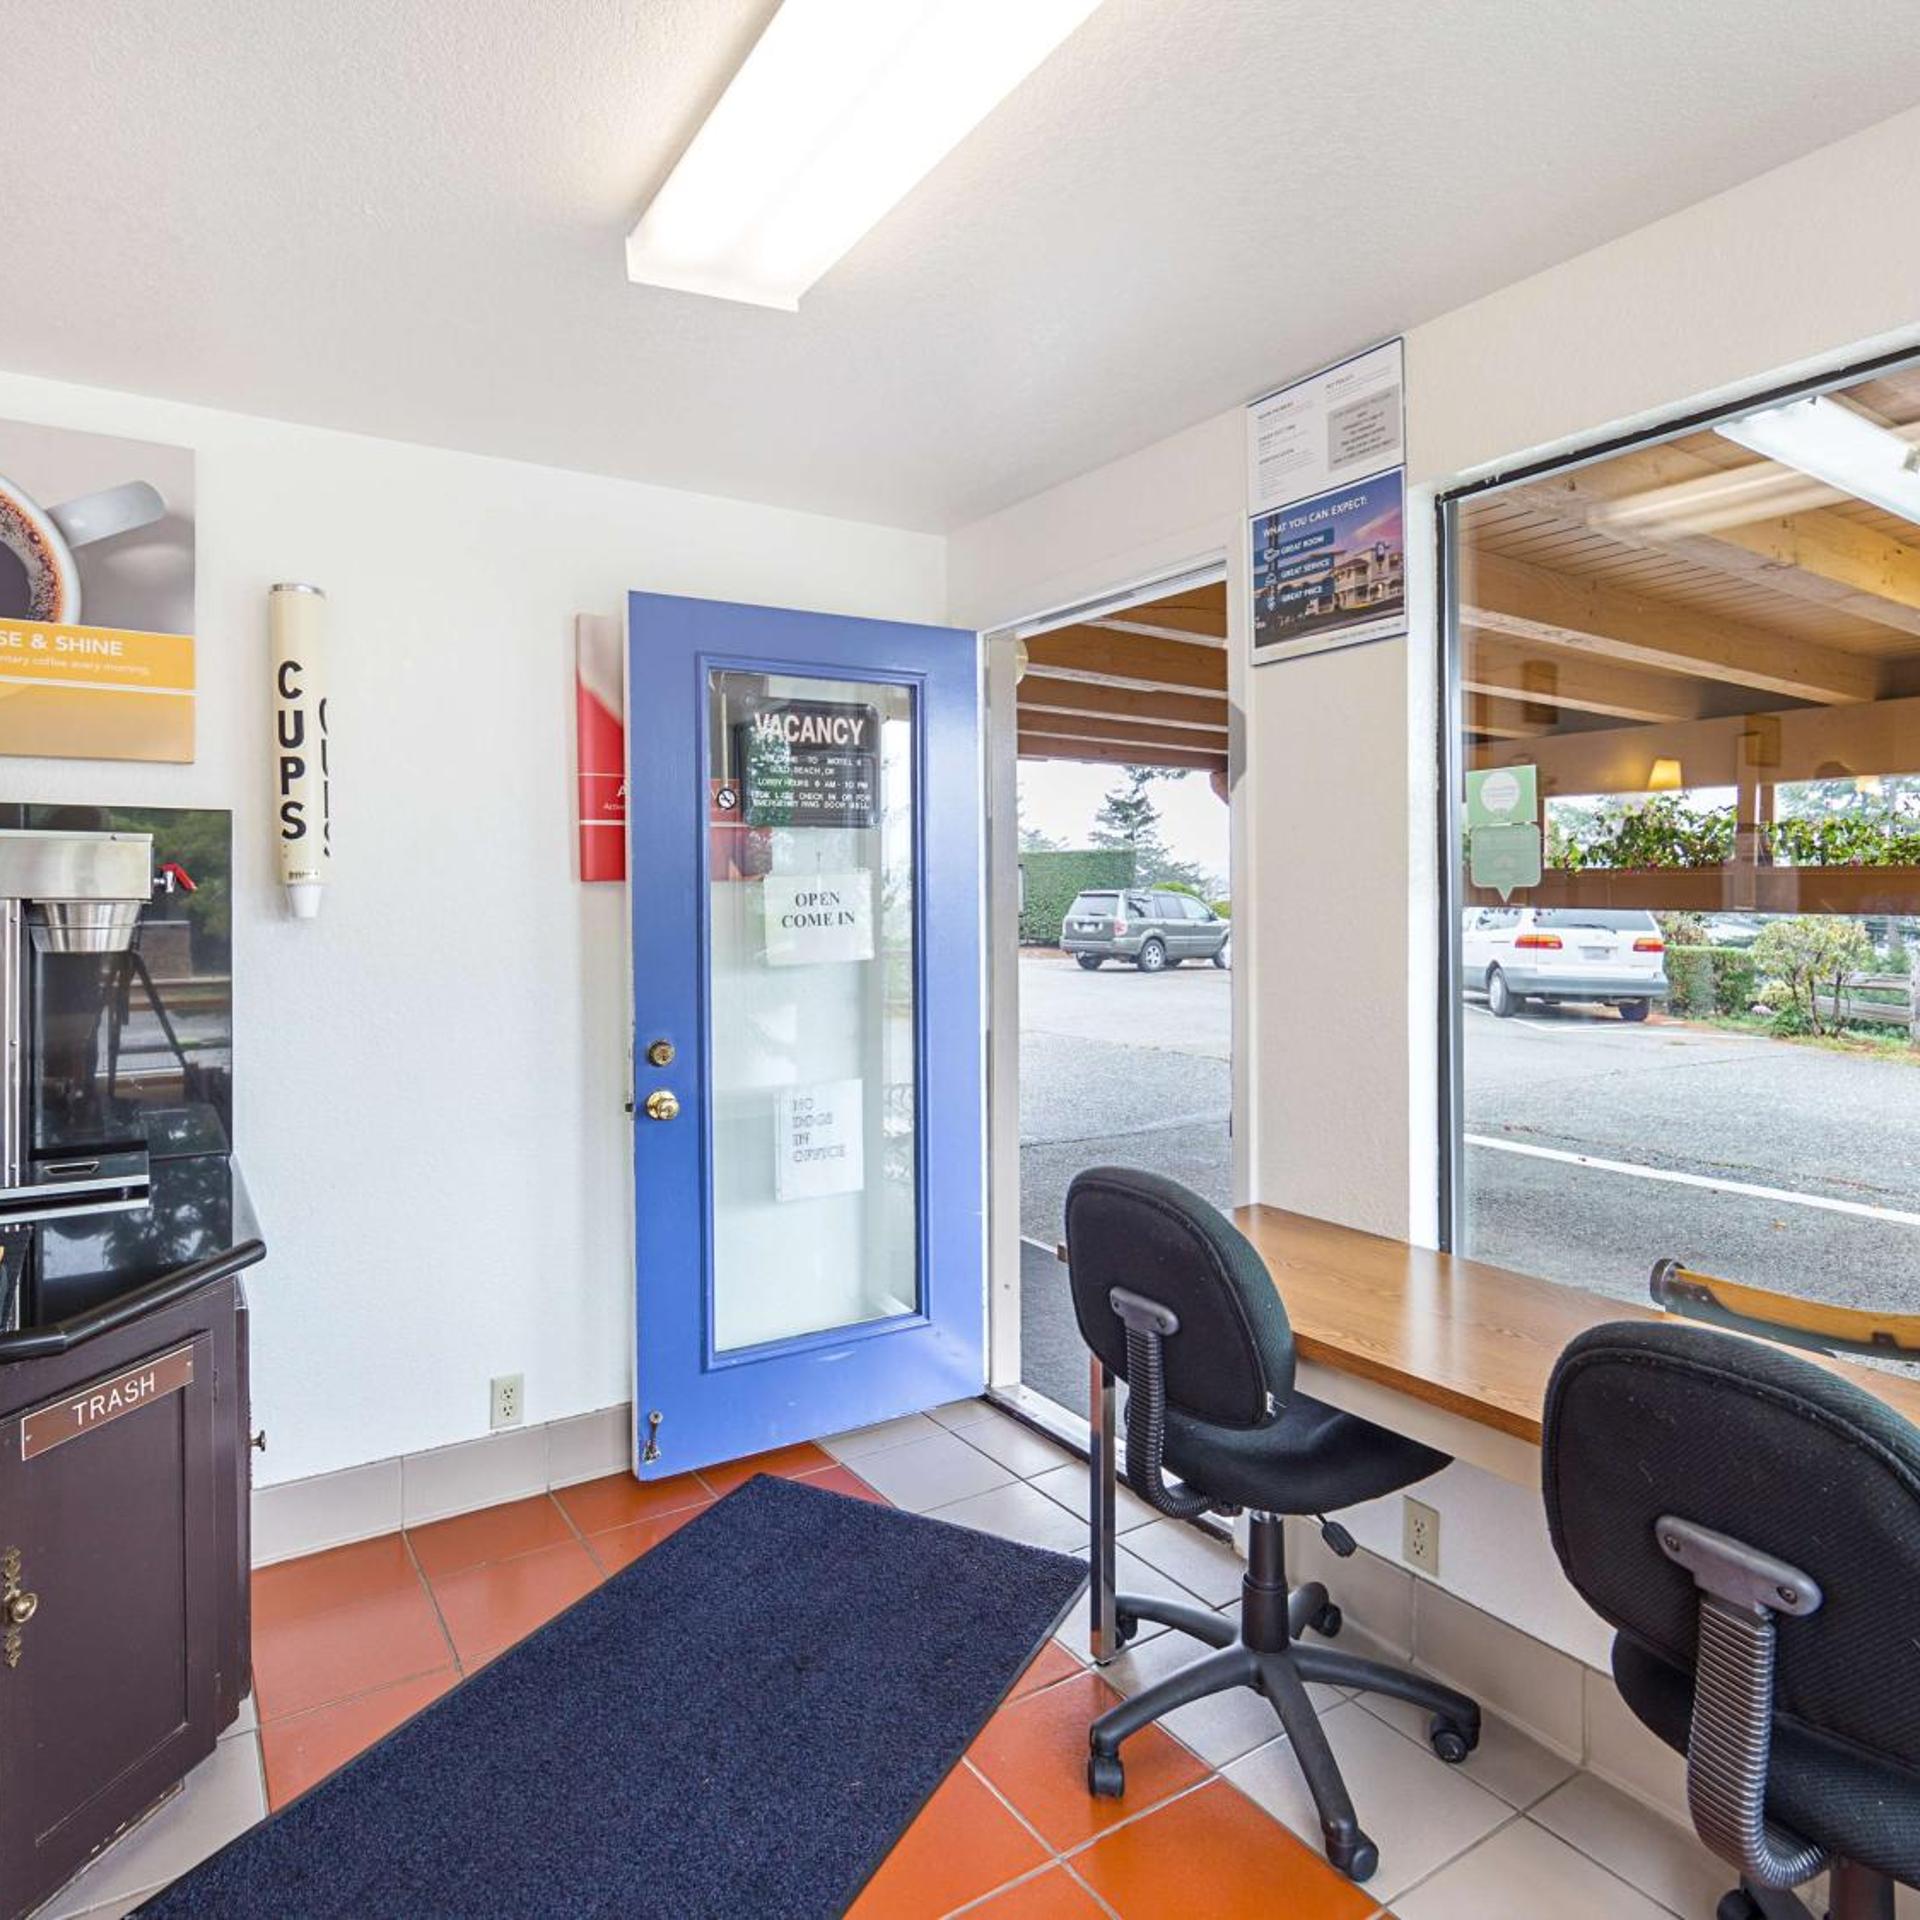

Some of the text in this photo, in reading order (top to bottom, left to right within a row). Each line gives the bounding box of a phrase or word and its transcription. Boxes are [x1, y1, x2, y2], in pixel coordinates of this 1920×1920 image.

[1263, 522, 1288, 538] WHAT
[1289, 517, 1307, 529] YOU
[1309, 510, 1330, 524] CAN
[1280, 534, 1325, 555] GREAT ROOM
[1303, 557, 1332, 573] SERVICE
[30, 632, 48, 649] &
[55, 634, 123, 657] SHINE
[754, 711, 864, 746] VACANCY
[277, 660, 308, 841] CUPS
[799, 791, 824, 801] CHECK
[795, 890, 840, 908] OPEN
[781, 911, 855, 929] COME IN
[792, 1097, 814, 1112] NO
[792, 1111, 833, 1129] DOGS
[792, 1131, 811, 1147] IN
[792, 1144, 846, 1163] OFFICE
[72, 1371, 156, 1425] TRASH
